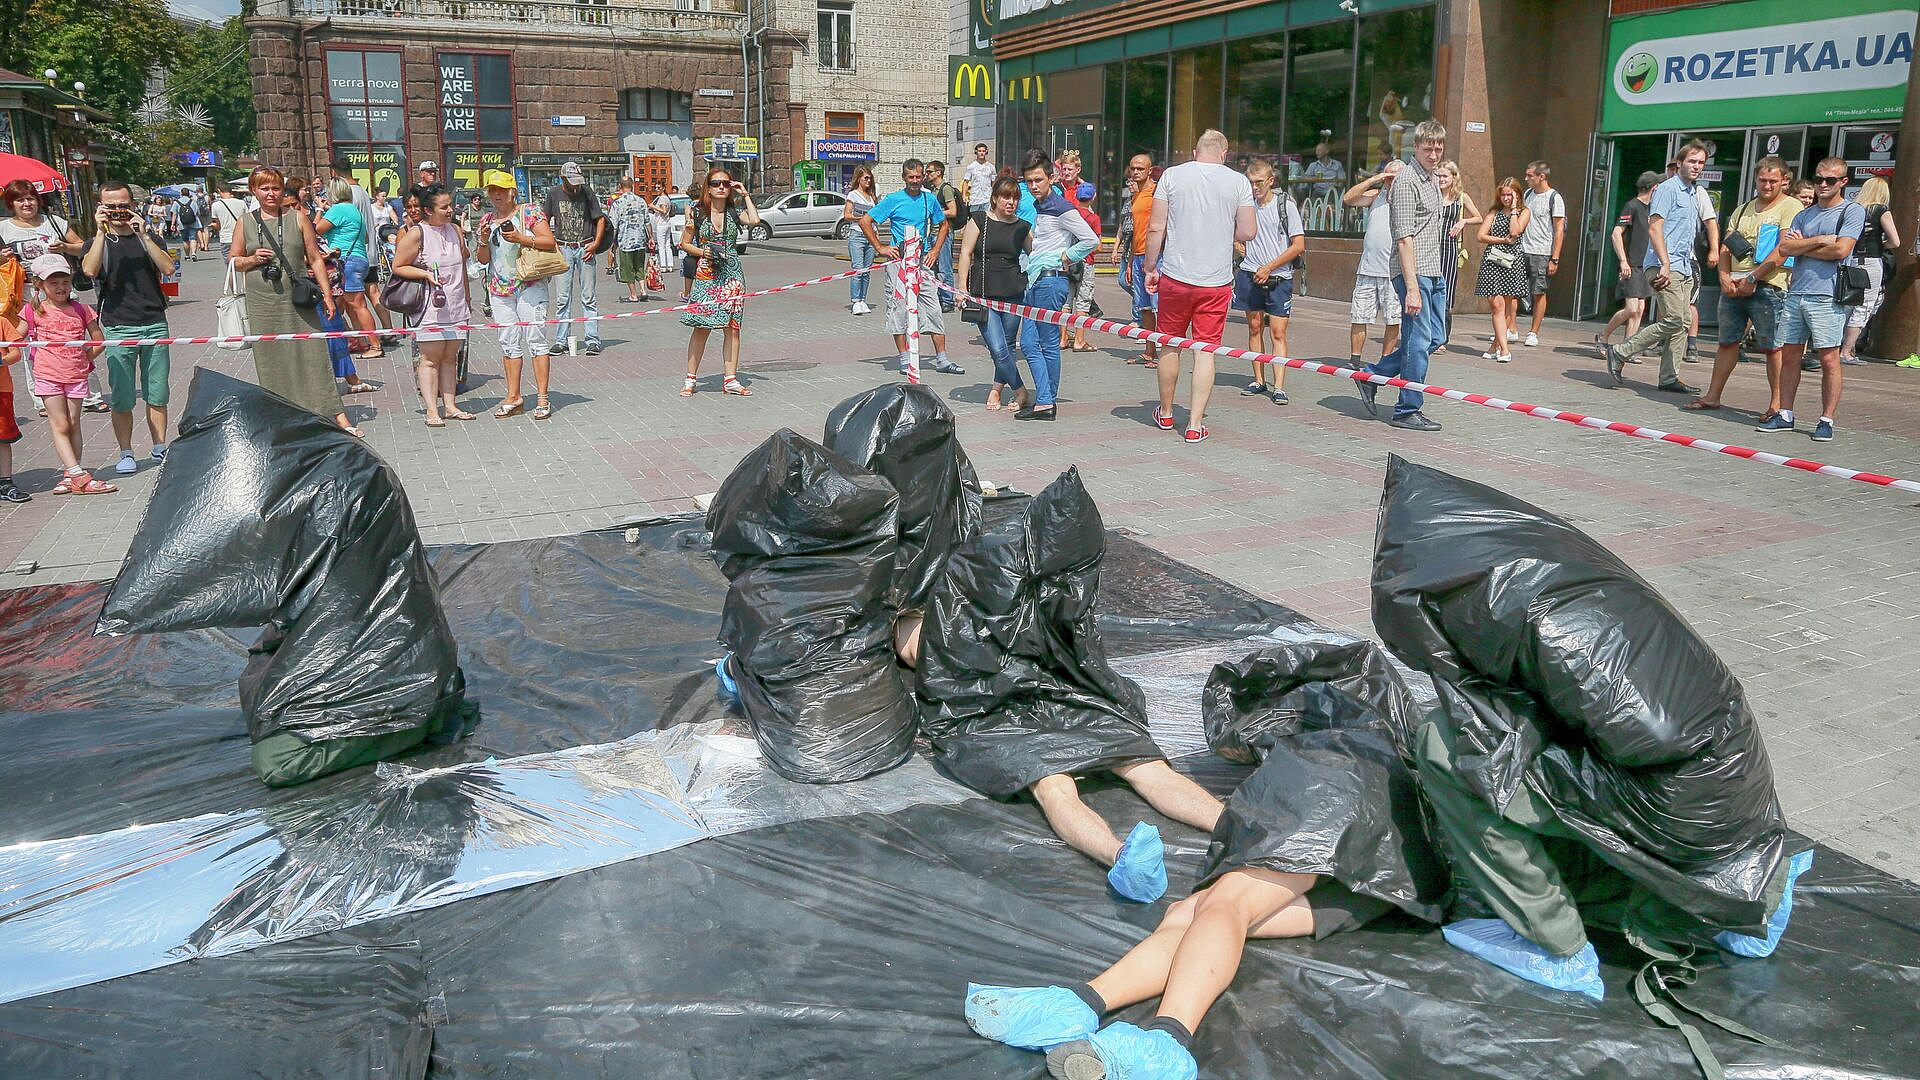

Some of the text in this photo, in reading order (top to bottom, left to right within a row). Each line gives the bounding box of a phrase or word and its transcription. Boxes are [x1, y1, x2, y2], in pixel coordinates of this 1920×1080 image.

[1664, 31, 1912, 84] ROZETKA.UA
[440, 66, 465, 79] WE
[442, 80, 473, 92] ARE
[442, 92, 463, 105] AS
[444, 107, 474, 117] YOU
[444, 119, 475, 131] ARE
